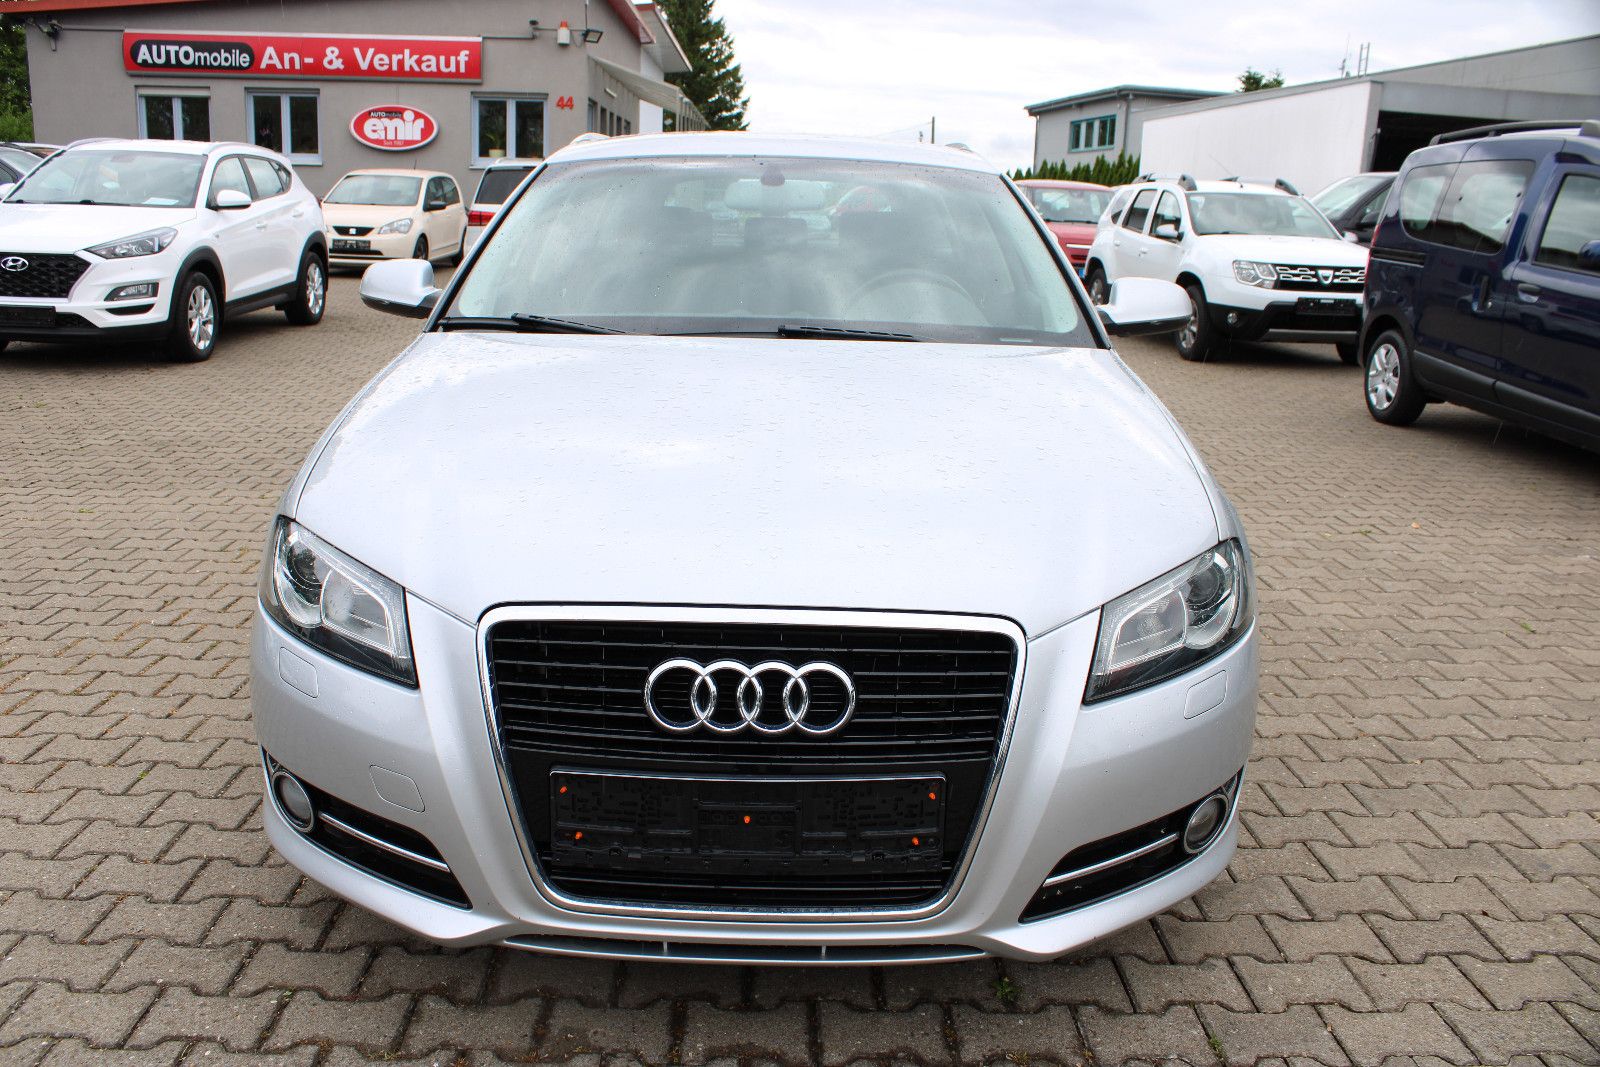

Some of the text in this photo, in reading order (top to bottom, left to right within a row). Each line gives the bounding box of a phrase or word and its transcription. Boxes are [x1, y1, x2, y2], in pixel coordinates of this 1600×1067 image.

[136, 44, 470, 73] AUTOmobile An- & Verkauf
[556, 95, 574, 110] 44
[363, 110, 424, 140] emir
